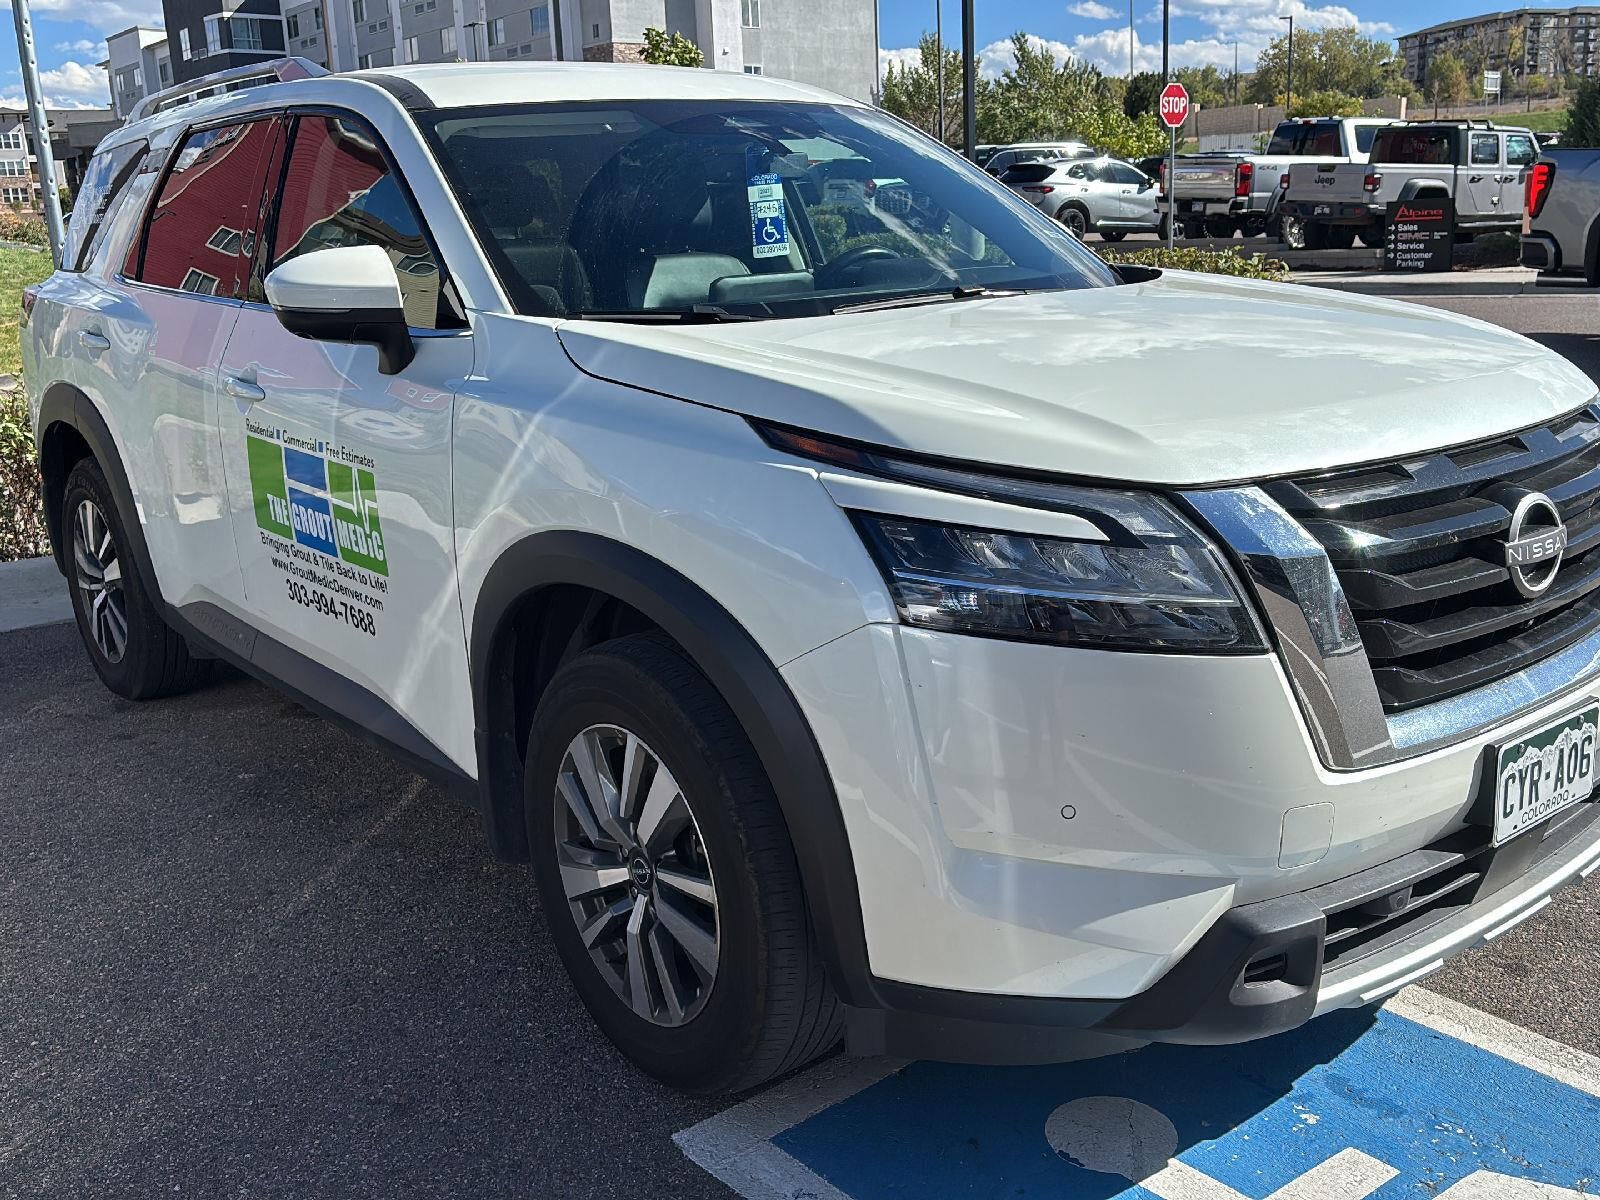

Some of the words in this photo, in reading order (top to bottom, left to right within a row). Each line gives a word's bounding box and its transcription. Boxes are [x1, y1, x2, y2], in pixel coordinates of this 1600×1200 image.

[1163, 97, 1187, 113] STOP
[1315, 175, 1335, 185] Jeep
[1395, 204, 1443, 217] Alpine
[1398, 232, 1430, 240] GMC
[1397, 260, 1424, 268] Parking
[246, 418, 275, 439] Residential
[283, 430, 317, 452] Commercial
[326, 442, 340, 459] Free
[341, 446, 375, 469] Estimates
[267, 493, 290, 526] THE
[291, 503, 334, 543] GROUT
[260, 532, 290, 558] Bringing
[290, 544, 313, 564] Grout
[312, 553, 320, 567] &
[319, 555, 335, 573] Tile
[335, 562, 358, 582] Back
[358, 571, 368, 586] to
[369, 574, 389, 594] Life!
[271, 556, 384, 612] www.GroutMedicDenver.com
[286, 579, 376, 636] 303-994-7688
[1503, 735, 1593, 819] CYR-A06
[1521, 790, 1569, 824] COLORADO
